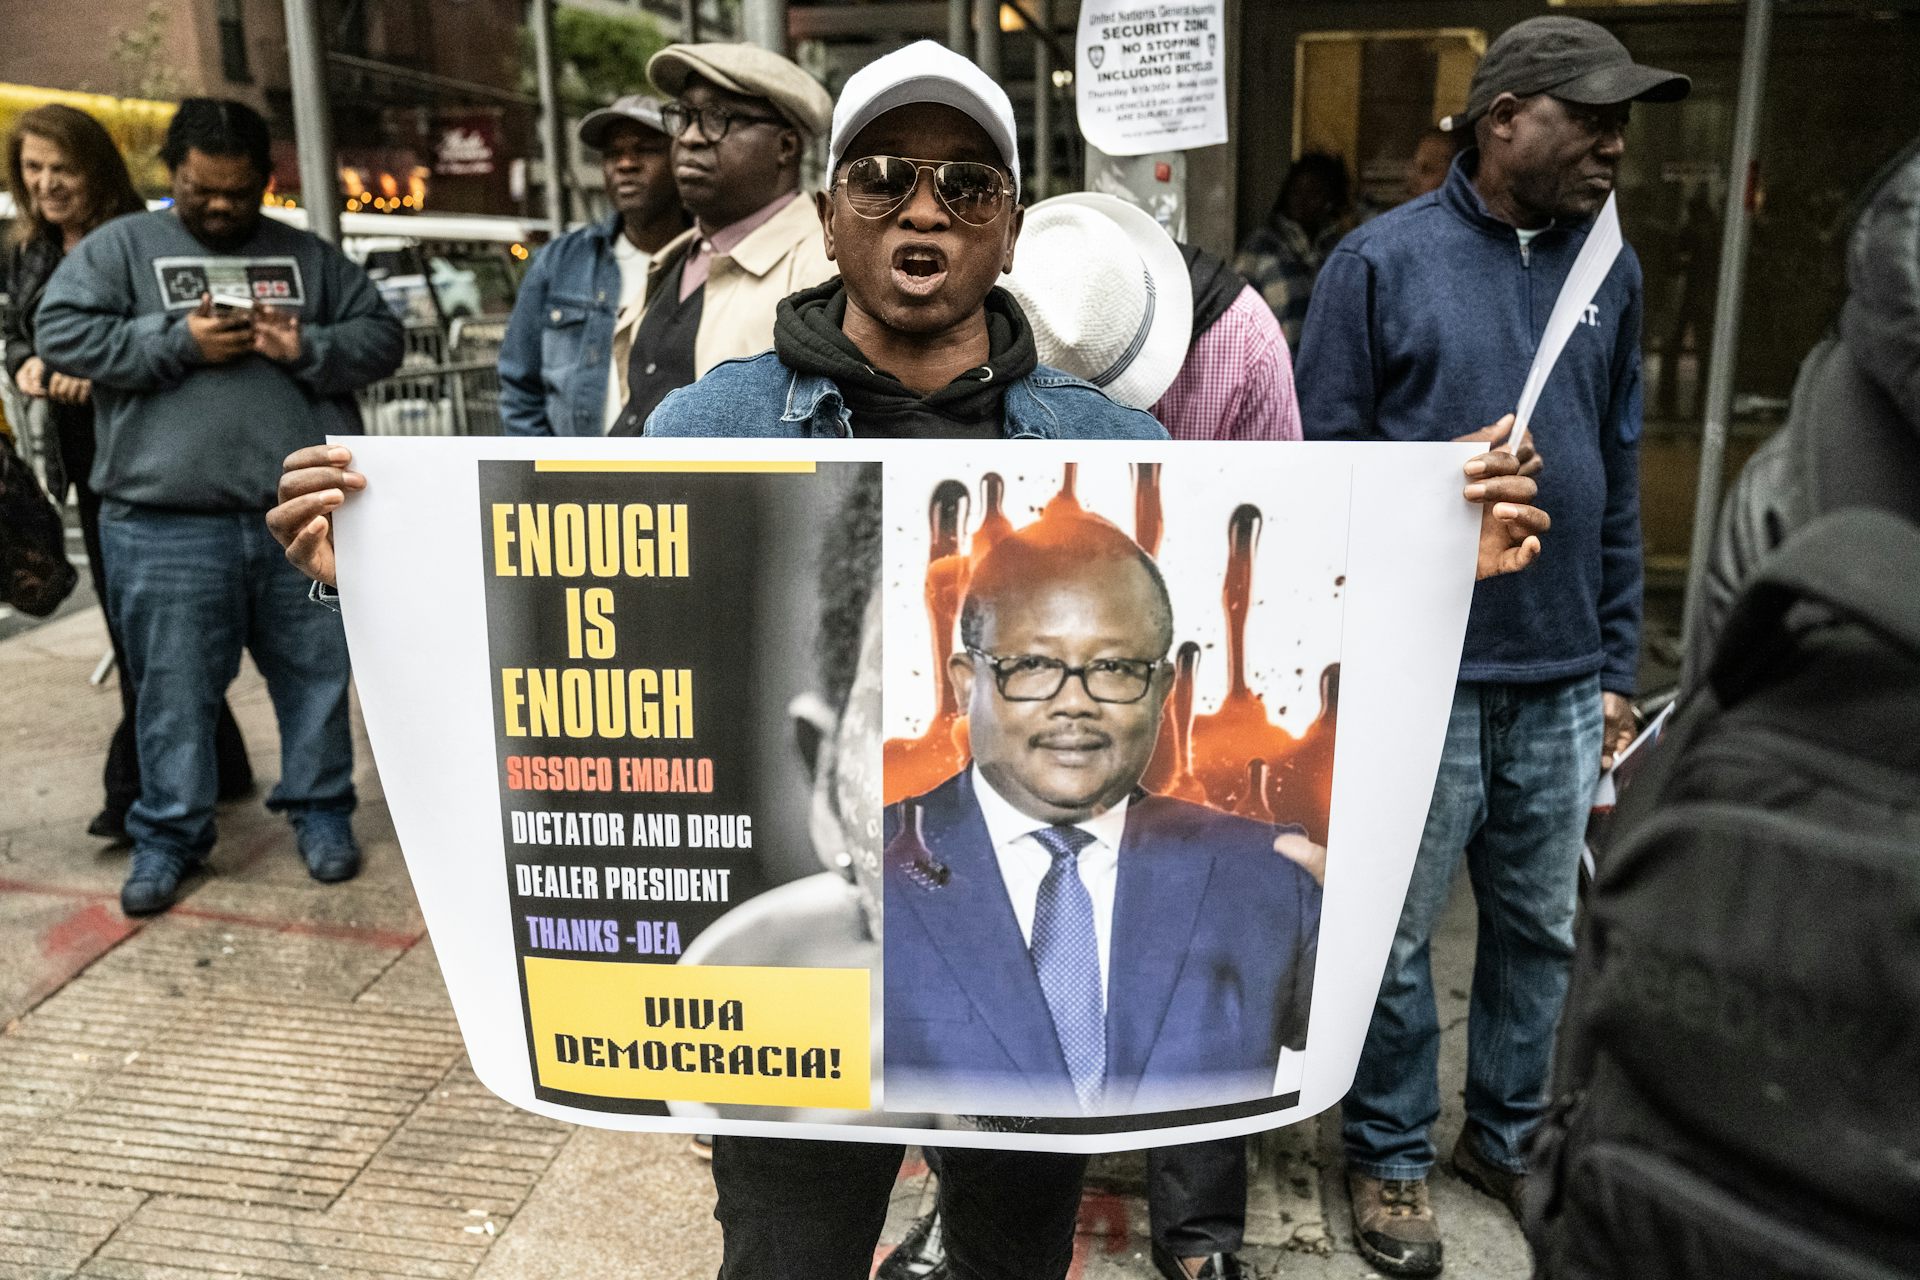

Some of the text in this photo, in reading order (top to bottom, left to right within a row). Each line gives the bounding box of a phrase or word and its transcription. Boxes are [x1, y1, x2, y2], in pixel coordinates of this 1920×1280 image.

[1090, 13, 1115, 25] United
[1118, 9, 1156, 20] Nations
[1102, 19, 1208, 40] SECURITY ZONE
[1122, 37, 1200, 54] NO STOPPING
[1139, 51, 1191, 64] ANYTIME
[1097, 66, 1171, 82] INCLUDING
[493, 503, 689, 577] ENOUGH
[566, 588, 616, 658] IS
[502, 668, 693, 738] ENOUGH
[506, 756, 714, 793] SISSOCO EMBALO
[511, 811, 752, 848] DICTATOR AND DRUG
[516, 864, 730, 902] DEALER PRESIDENT
[526, 915, 681, 955] THANKS -DEA
[645, 997, 744, 1031] VIVA
[555, 1033, 842, 1079] DEMOCRACIA!
